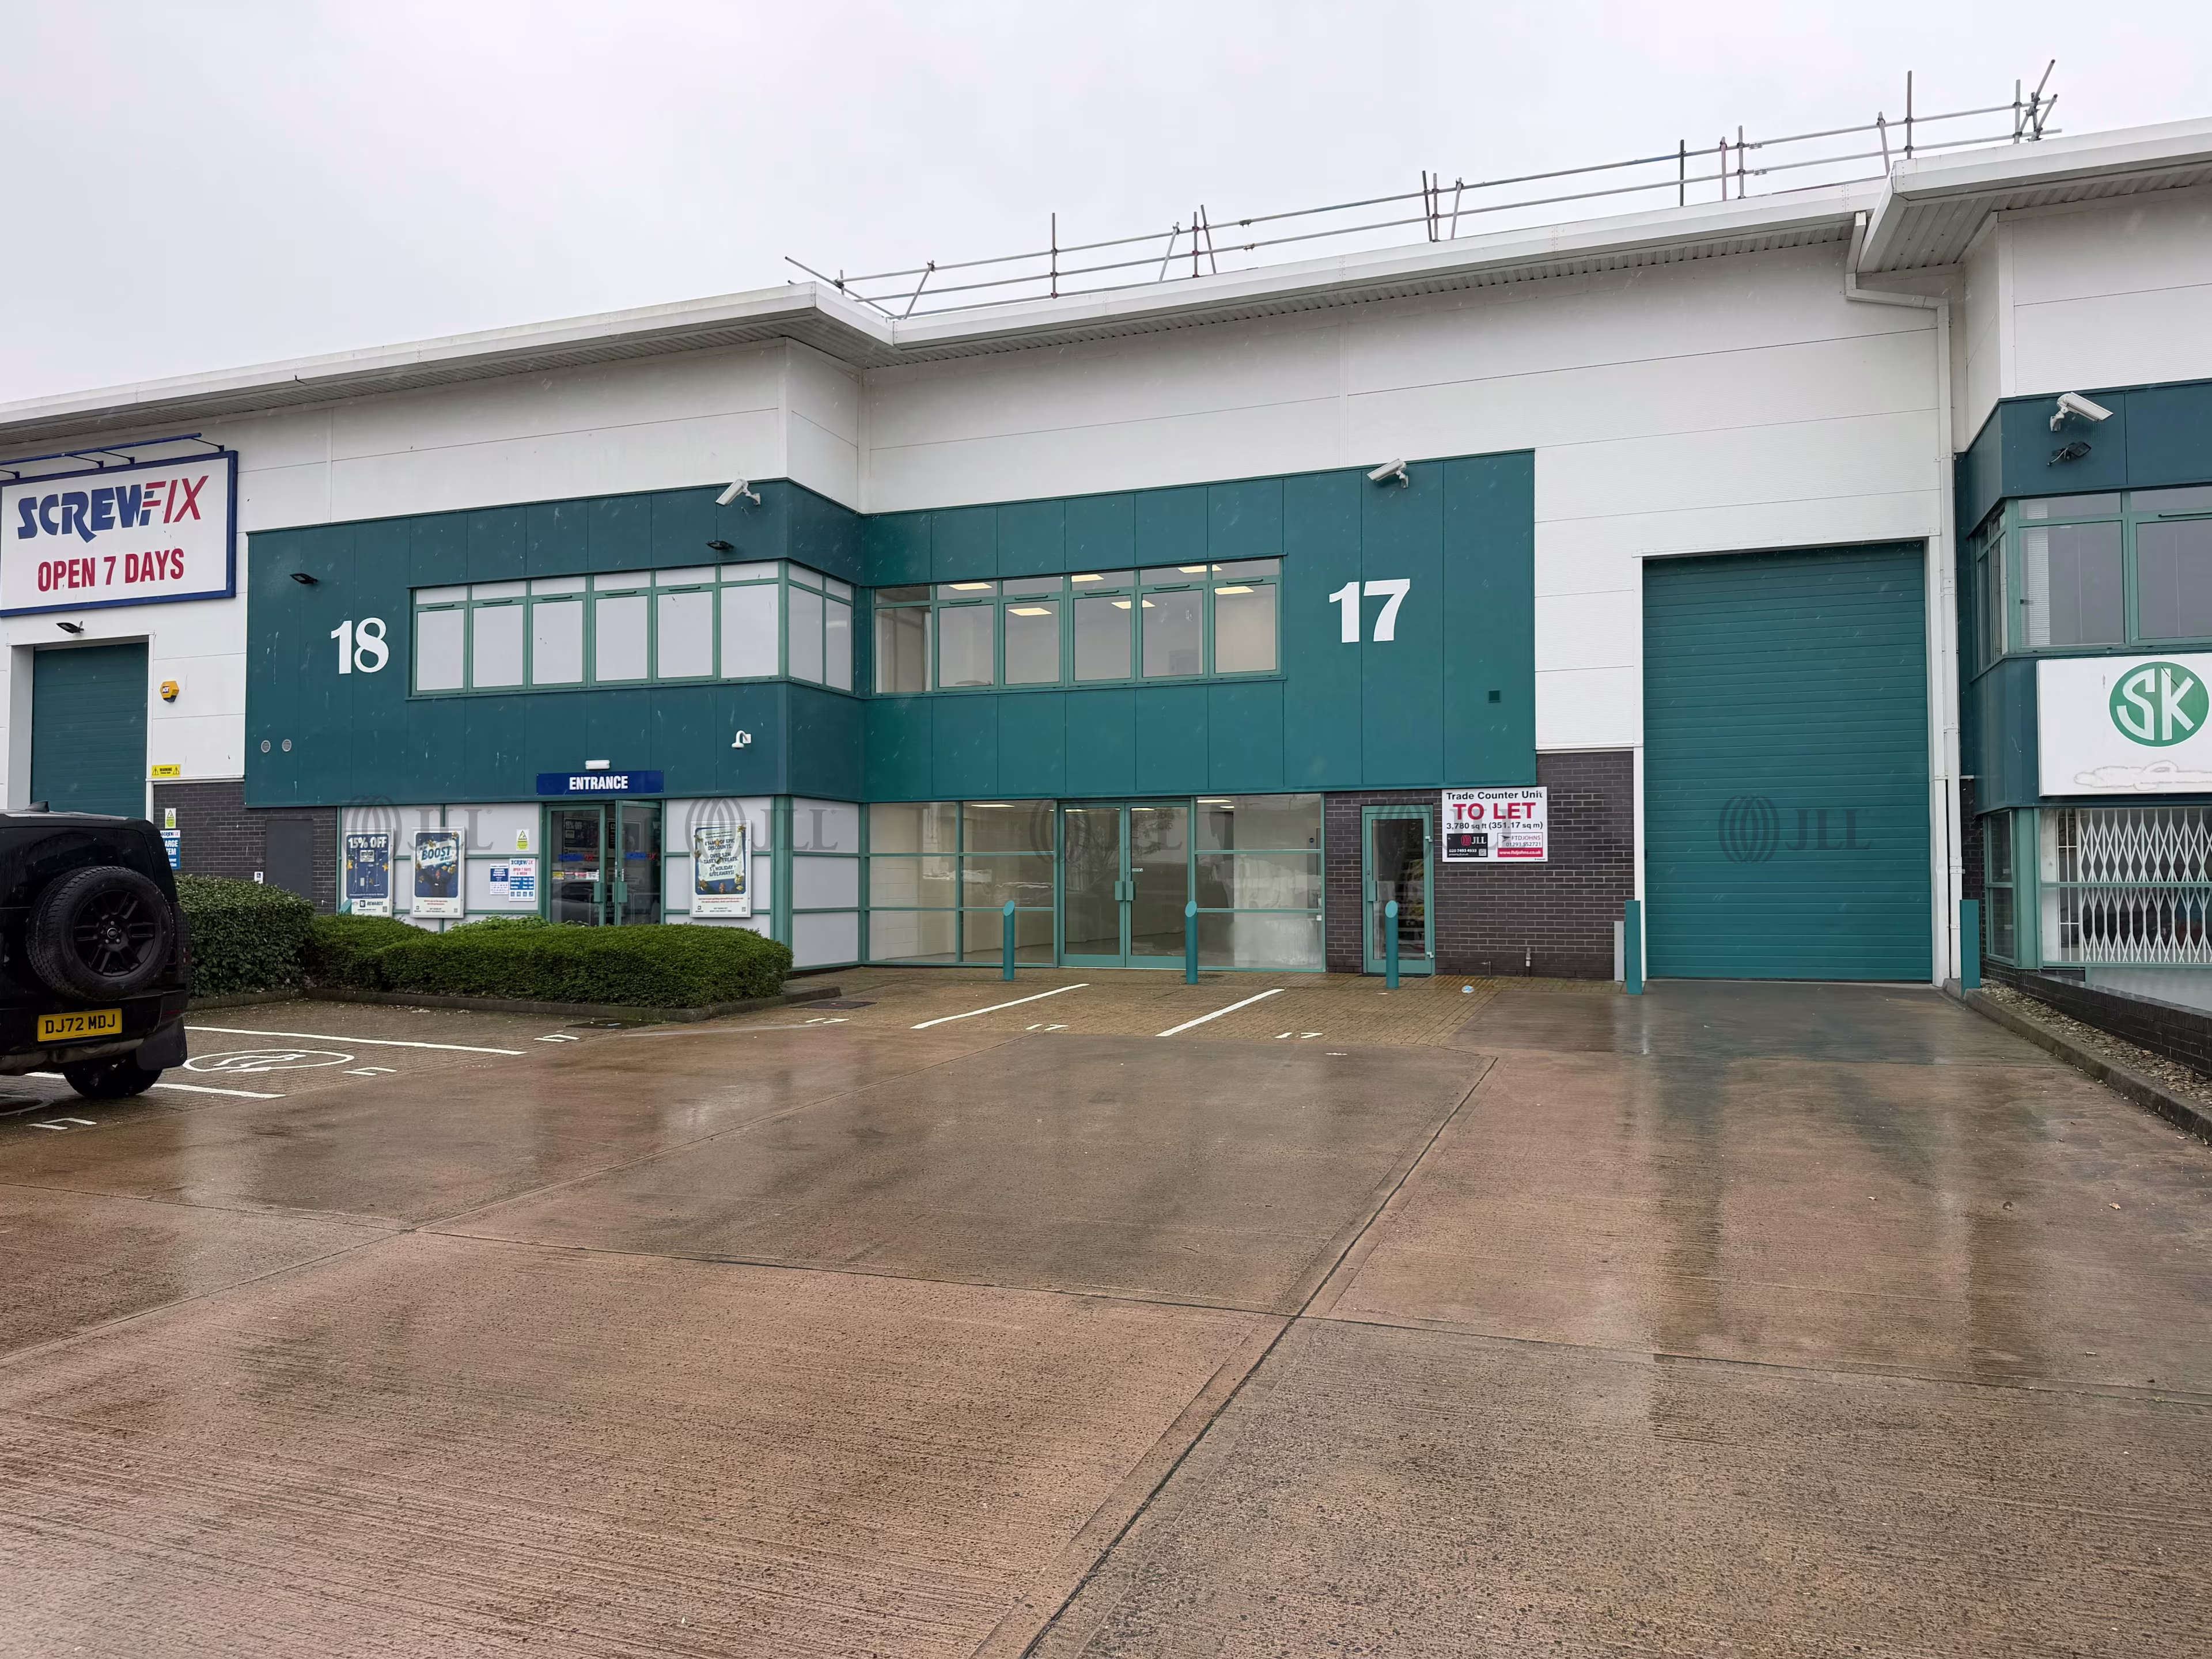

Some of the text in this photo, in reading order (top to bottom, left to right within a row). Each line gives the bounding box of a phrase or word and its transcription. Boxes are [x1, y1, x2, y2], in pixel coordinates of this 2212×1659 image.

[17, 475, 209, 543] SCREWFIX
[38, 548, 184, 592] OPEN 7 DAYS
[1329, 578, 1410, 643] 17
[331, 617, 389, 674] 18
[2116, 668, 2195, 741] SK
[569, 775, 628, 790] ENTRANCE
[1478, 791, 1518, 800] Counter
[1522, 790, 1543, 798] Unit
[1453, 802, 1536, 820] TO LET
[1488, 822, 1520, 830] (351.17
[348, 836, 387, 849] 15% OFF
[1471, 836, 1487, 844] JLL
[421, 846, 452, 861] BOOST
[45, 1014, 115, 1034] DJ72 MDJ
